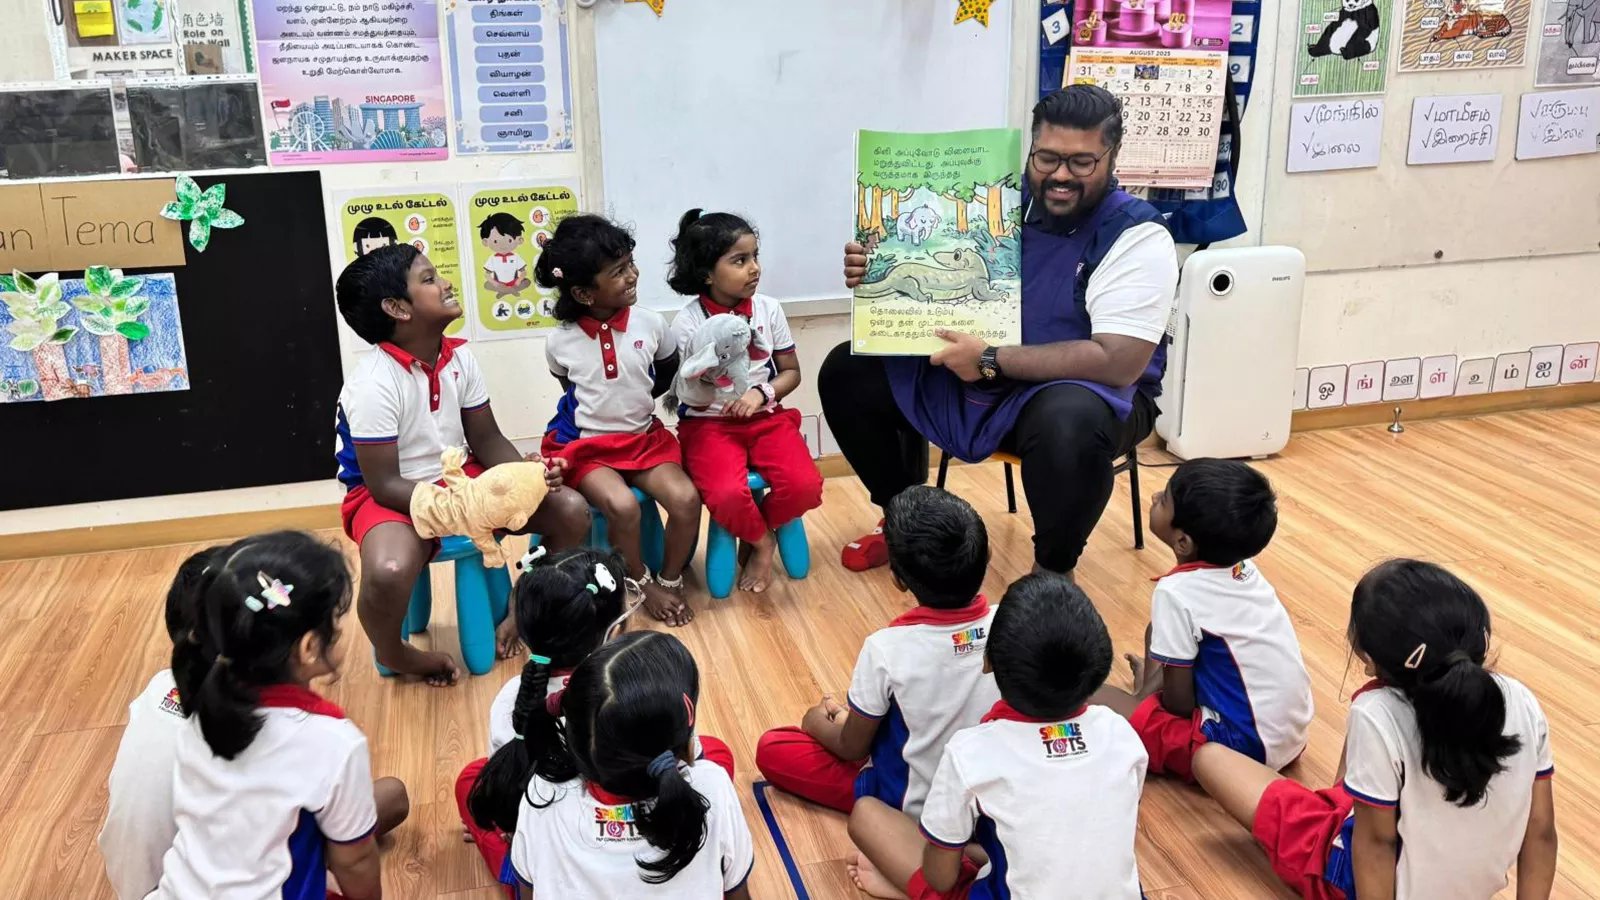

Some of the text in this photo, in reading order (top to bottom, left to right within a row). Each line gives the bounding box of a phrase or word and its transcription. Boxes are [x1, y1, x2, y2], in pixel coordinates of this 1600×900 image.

[348, 3, 360, 11] நம்
[362, 3, 379, 12] நாடு
[183, 12, 224, 27] 角色墙
[489, 9, 523, 19] திங்கள்
[1052, 20, 1061, 34] 3
[1232, 23, 1243, 35] 2
[183, 30, 206, 38] Role
[486, 29, 530, 38] செவ்வாய்
[93, 49, 173, 62] MAKER SPACE
[497, 49, 521, 59] புதன்
[489, 69, 532, 80] வியாழன்
[1080, 66, 1092, 76] 31
[1207, 69, 1213, 79] 2
[1230, 63, 1241, 75] 9
[1123, 82, 1129, 91] 5
[1144, 83, 1150, 91] 6
[1165, 83, 1171, 92] 7
[1185, 83, 1191, 92] 8
[1206, 84, 1212, 93] 9
[365, 95, 416, 103] SINGAPORE
[493, 89, 531, 98] வெள்ளி
[1140, 97, 1151, 107] 13
[1161, 98, 1172, 107] 14
[1182, 98, 1193, 107] 15
[1203, 98, 1213, 108] 16
[504, 109, 523, 117] சனி
[1138, 112, 1150, 121] 20
[1159, 112, 1171, 121] 21
[1180, 113, 1192, 122] 22
[1200, 114, 1212, 123] 23
[497, 129, 533, 139] ஞாயிறு
[1136, 126, 1149, 136] 27
[1156, 127, 1169, 136] 28
[1177, 127, 1190, 136] 29
[1198, 127, 1210, 137] 30
[1431, 124, 1493, 153] இறைச்சி
[1215, 180, 1228, 192] 30
[475, 191, 570, 207] முழு உடல் கேட்டல்
[347, 198, 447, 214] முழு உடல் கேட்டல்
[51, 196, 155, 246] Tema
[898, 319, 914, 327] தன்
[1504, 364, 1519, 379] ம்
[1535, 362, 1552, 378] ஐ
[1357, 374, 1373, 390] ங்
[1390, 375, 1414, 386] ஊ
[1469, 374, 1483, 385] உ
[952, 628, 985, 644] SPARKLE
[1039, 723, 1081, 739] SPARKLE
[1043, 737, 1086, 754] TOTS
